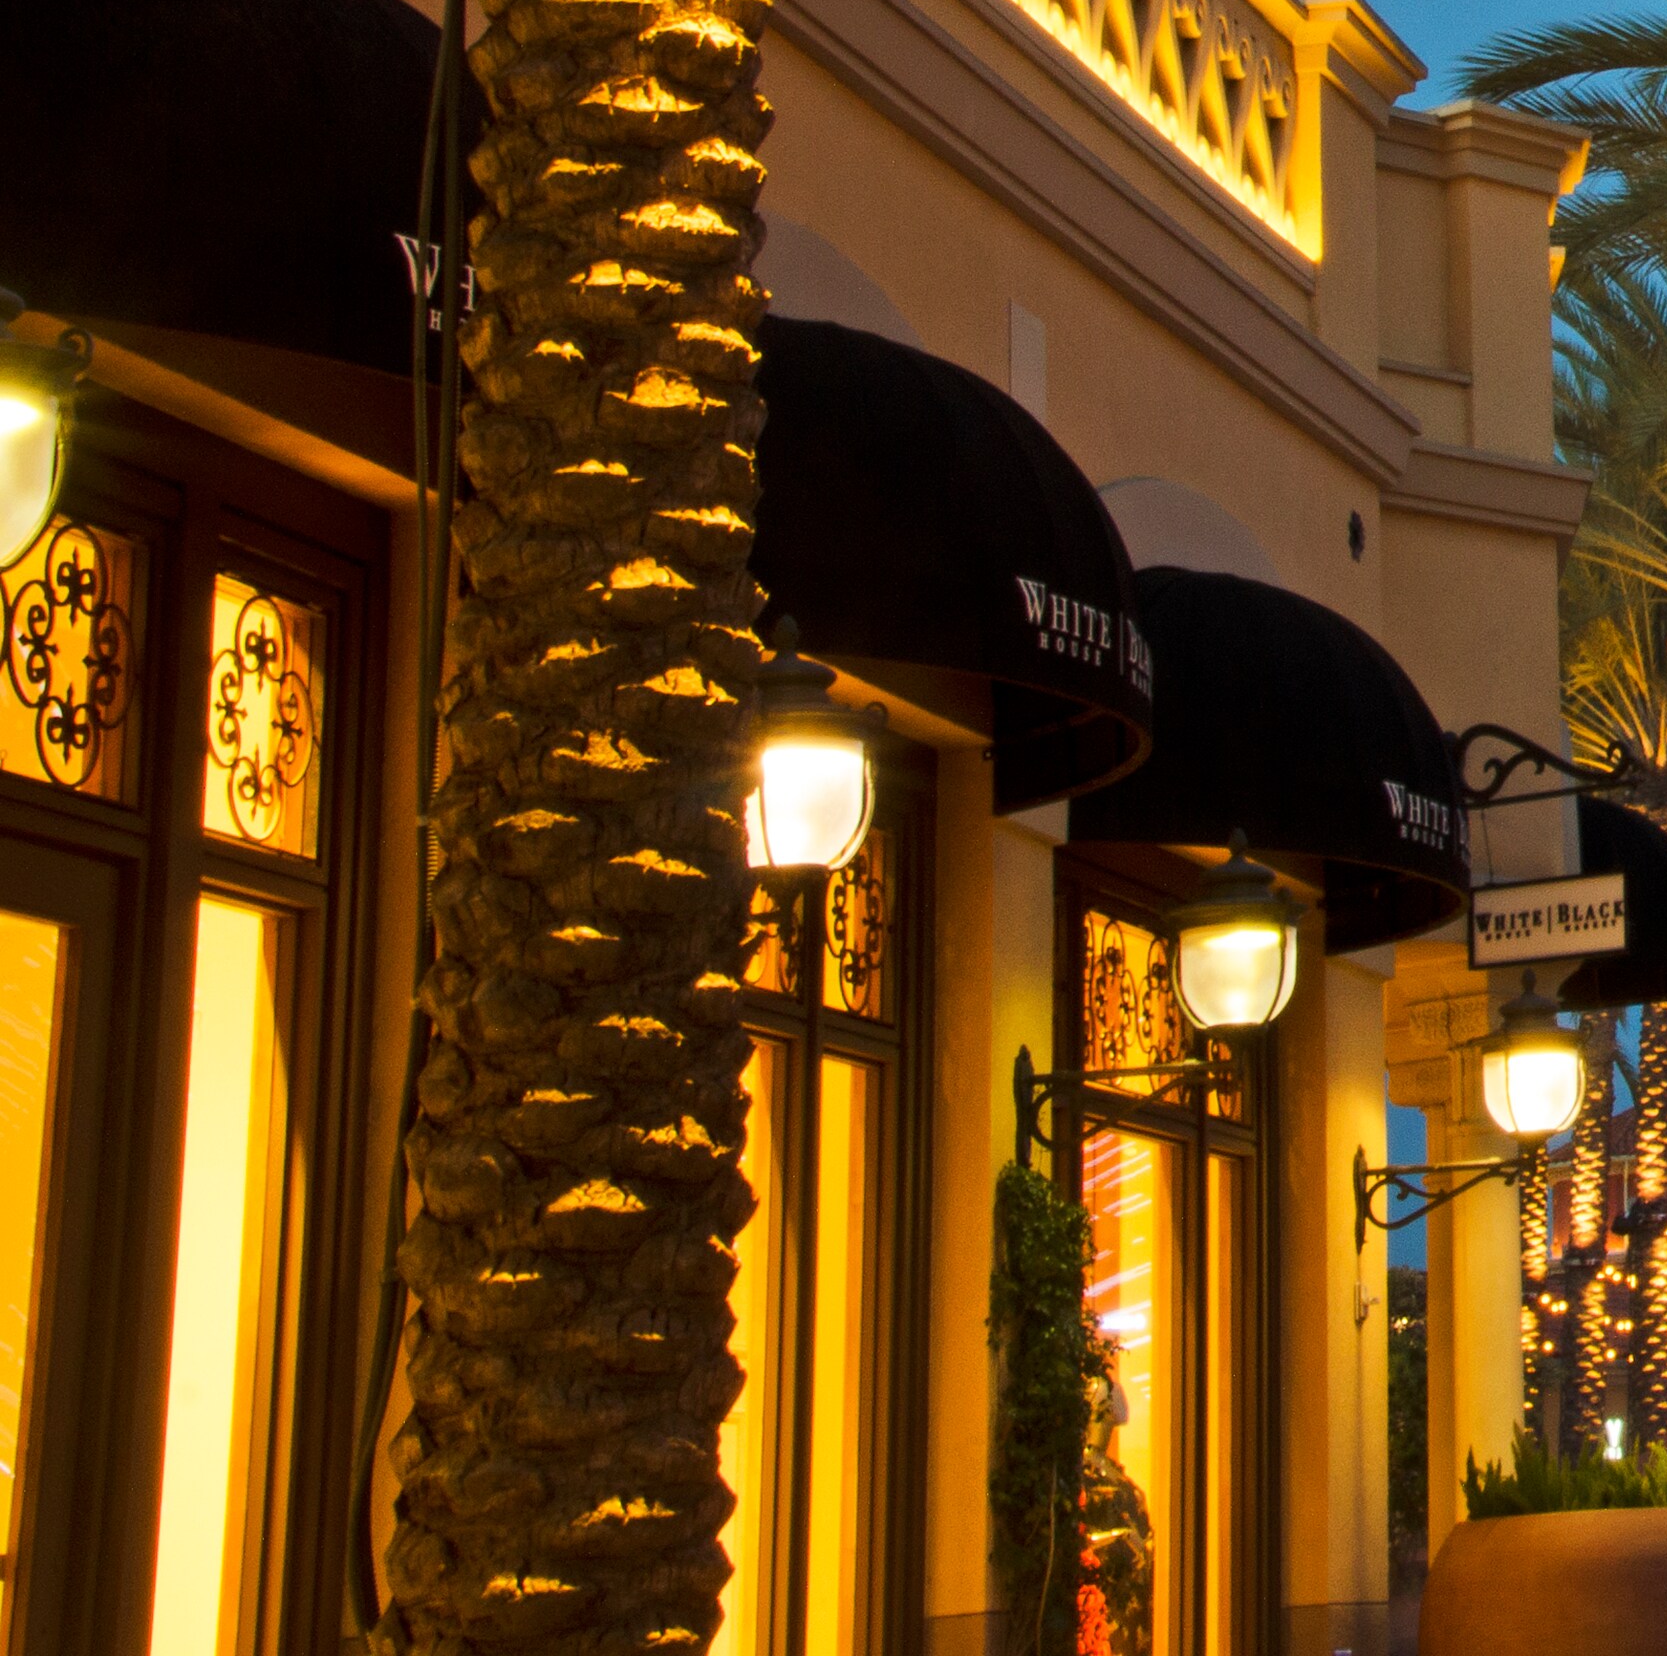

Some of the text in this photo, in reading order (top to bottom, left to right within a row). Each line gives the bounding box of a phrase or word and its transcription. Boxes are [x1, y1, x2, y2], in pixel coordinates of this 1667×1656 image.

[1015, 576, 1111, 649] WHITE
[1039, 631, 1101, 667] HOUSE
[1383, 780, 1449, 835] WHITE
[1476, 900, 1624, 932] WHITE BLACK
